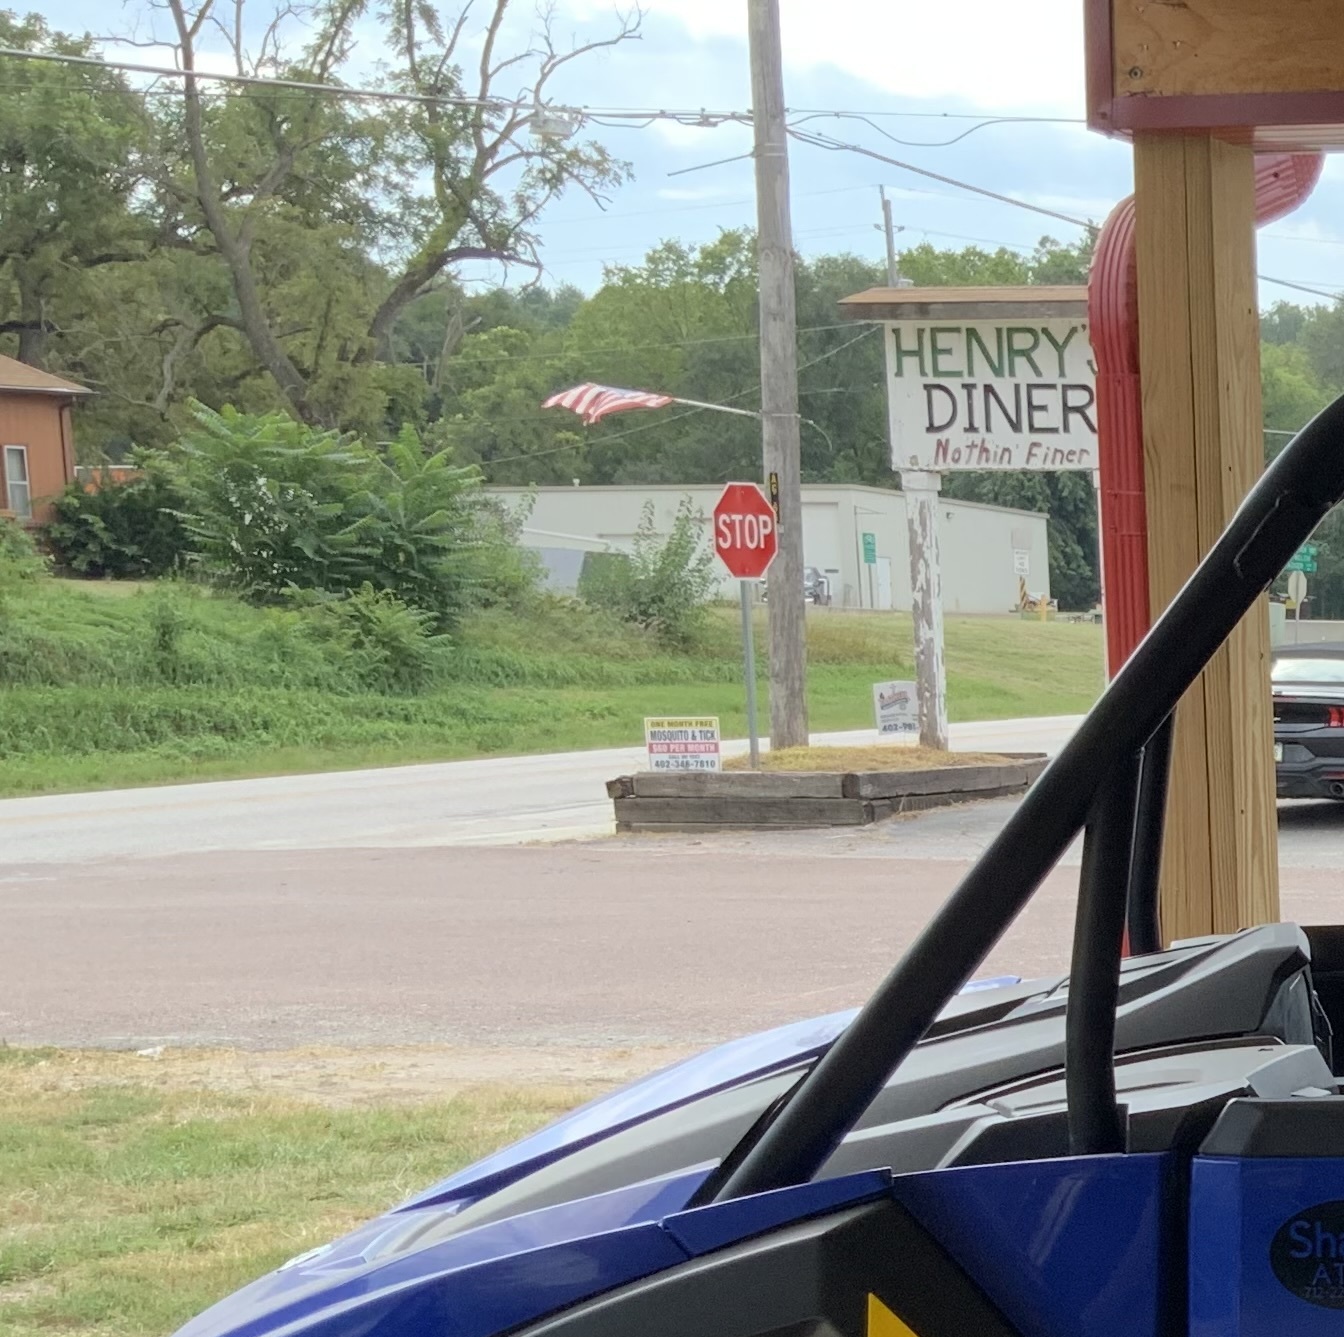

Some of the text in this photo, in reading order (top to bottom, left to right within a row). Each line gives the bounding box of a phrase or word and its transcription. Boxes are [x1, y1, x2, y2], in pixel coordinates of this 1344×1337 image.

[922, 383, 1099, 434] DINER
[934, 438, 1091, 465] Nothin' Finer
[718, 514, 773, 550] STOP
[650, 730, 716, 741] MOSQUITO & TICK
[669, 743, 686, 753] PER
[687, 743, 716, 753] MONTH
